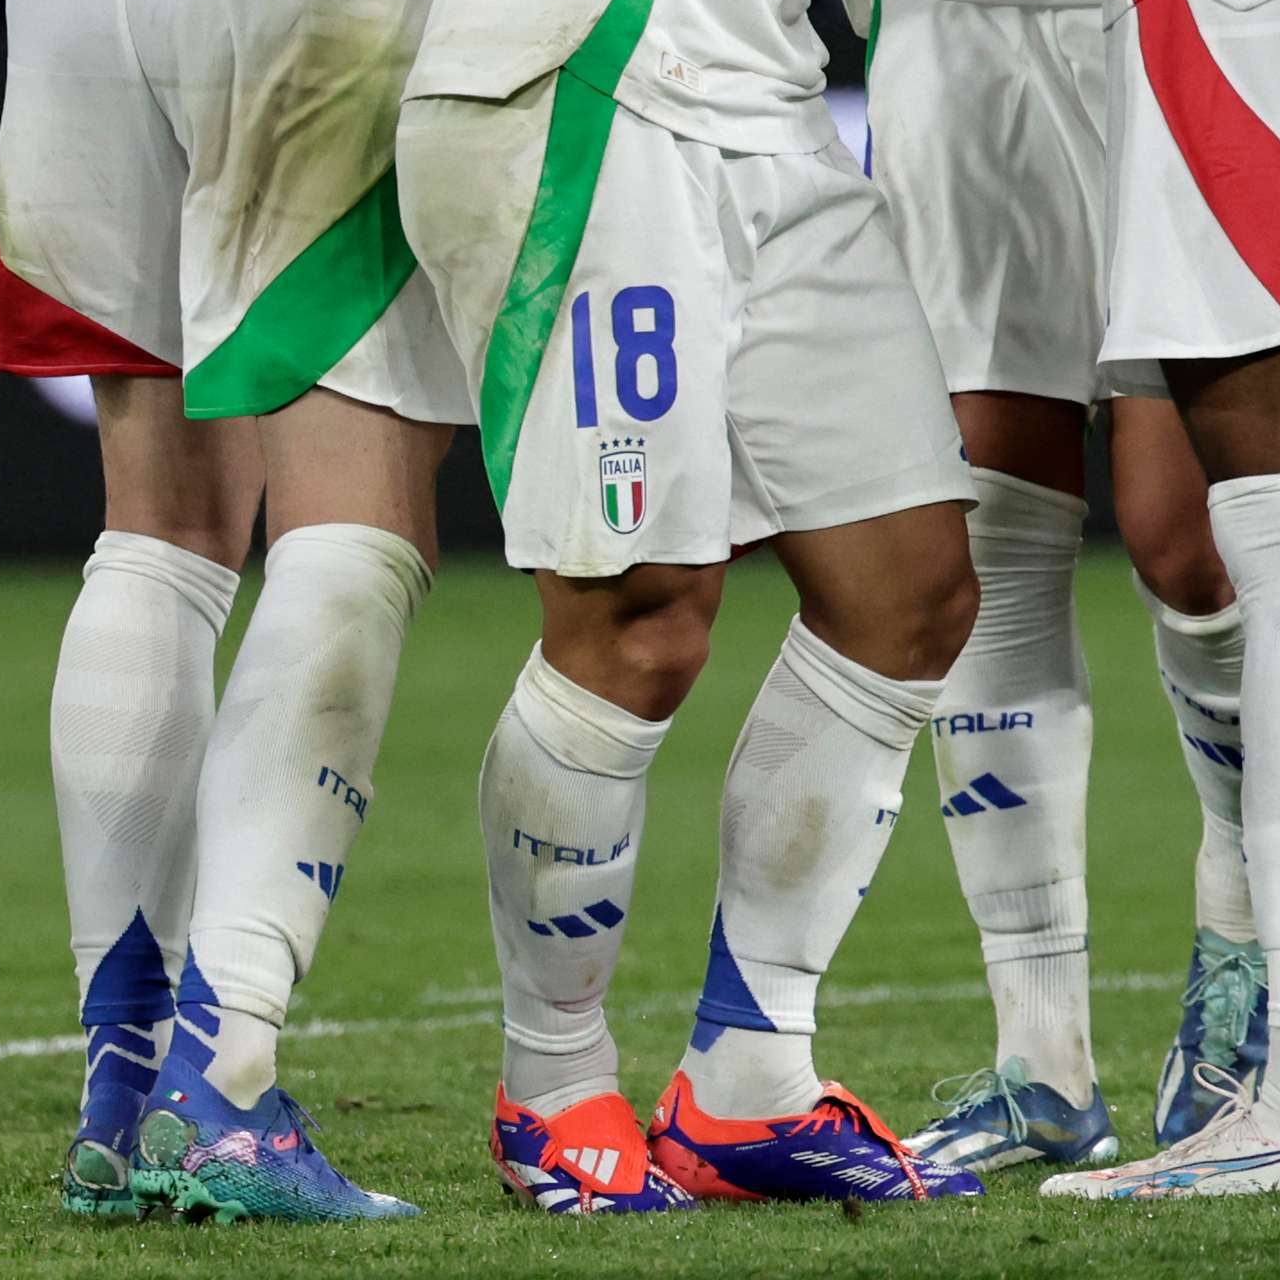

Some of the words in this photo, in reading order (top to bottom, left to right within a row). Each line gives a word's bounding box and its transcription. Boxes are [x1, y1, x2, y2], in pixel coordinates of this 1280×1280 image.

[571, 285, 678, 428] 18
[603, 458, 642, 475] ITALIA
[513, 828, 630, 865] ITALIA
